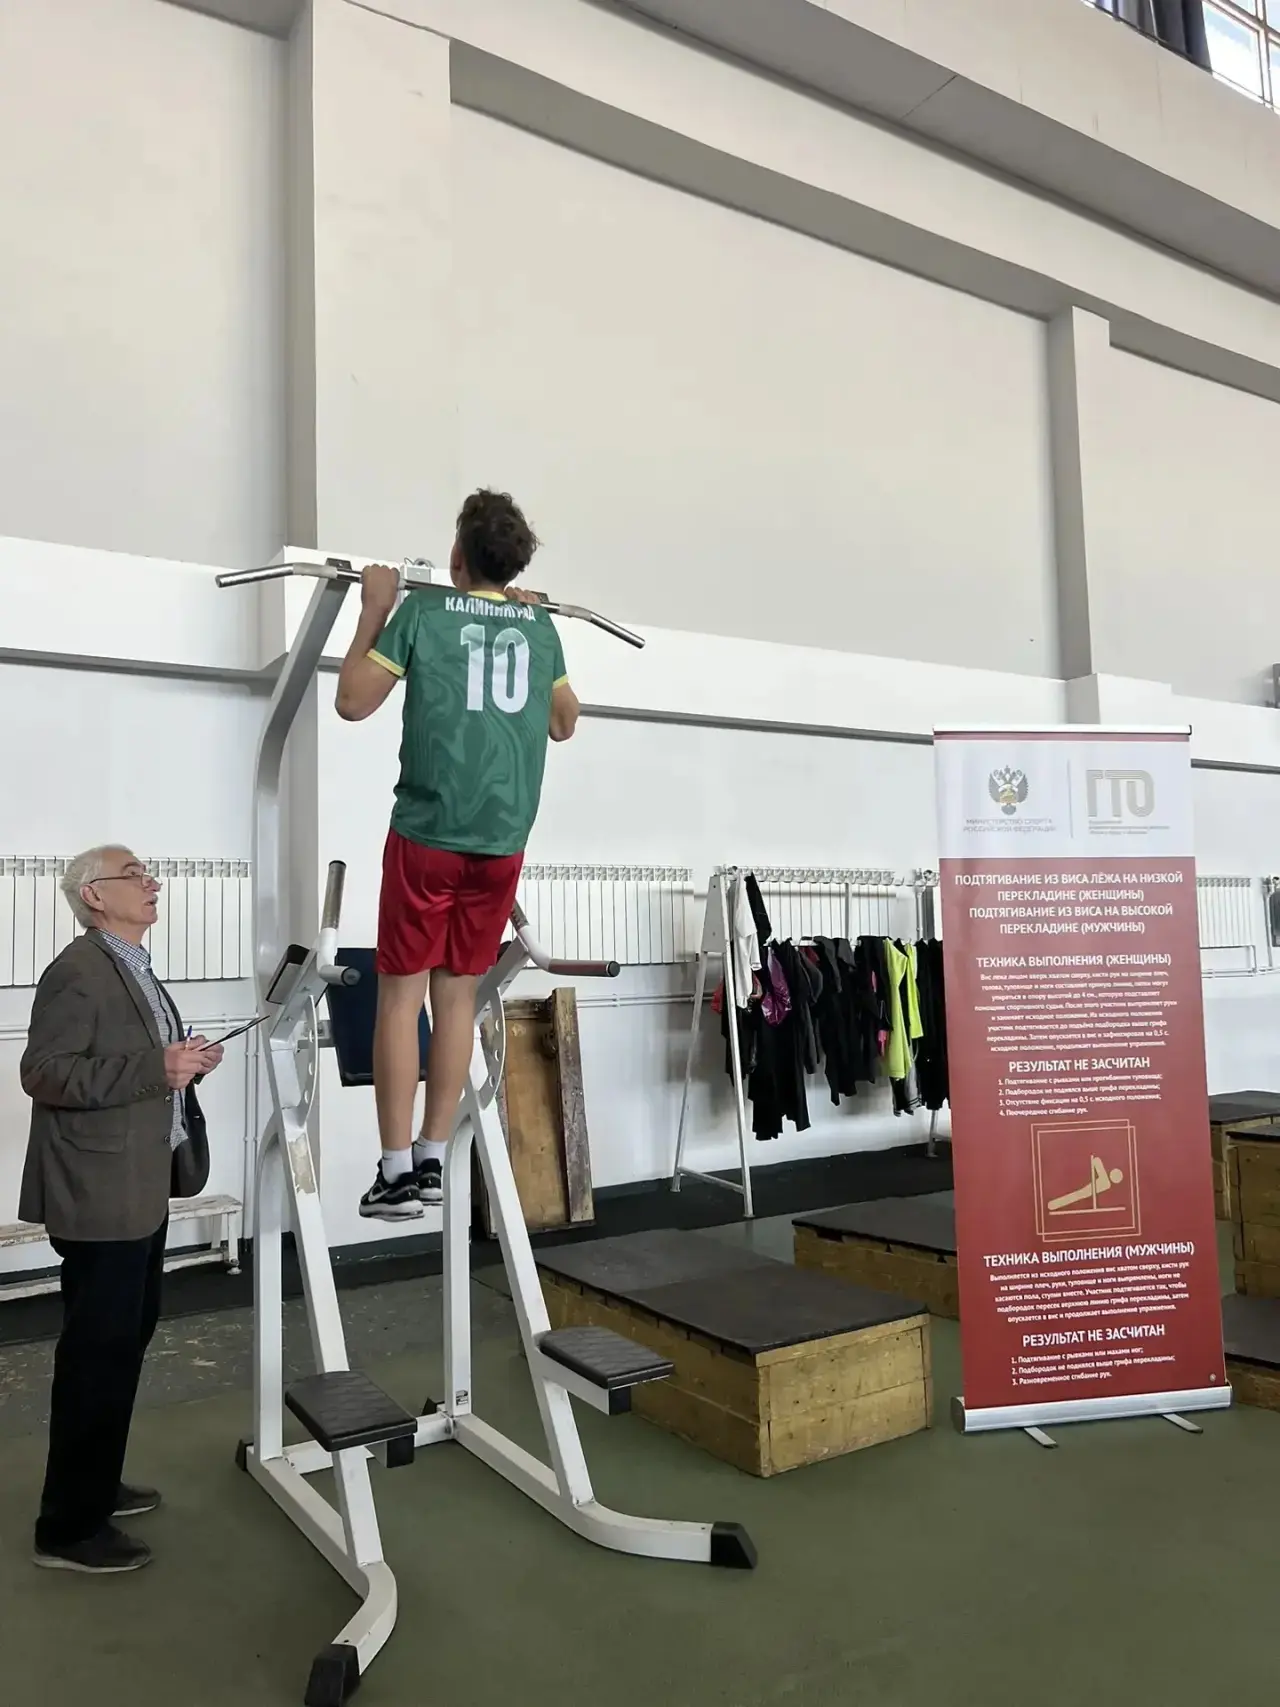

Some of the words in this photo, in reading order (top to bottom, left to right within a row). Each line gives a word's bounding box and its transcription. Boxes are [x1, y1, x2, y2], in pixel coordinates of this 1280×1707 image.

[460, 624, 530, 714] 10
[1086, 770, 1155, 818] ГТО
[955, 874, 1042, 885] ПОДТЯГИВАНИЕ
[1044, 874, 1059, 884] ИЗ
[1061, 874, 1089, 884] ВИСА
[1123, 874, 1137, 883] НА
[1140, 871, 1183, 883] НИЗКОЙ
[998, 890, 1076, 901] ПЕРЕКЛАДИНЕ
[1079, 890, 1144, 901] (ЖЕНЩИНЫ)
[970, 907, 1055, 918] ПОДТЯГИВАНИЕ
[1058, 906, 1072, 917] ИЗ
[1075, 906, 1102, 916] ВИСА
[1105, 906, 1119, 916] НА
[1121, 903, 1172, 916] ВЫСОКОЙ
[1000, 923, 1079, 934] ПЕРЕКЛАДИНЕ
[1081, 922, 1145, 934] (МУЖЧИНЫ)
[976, 957, 1026, 967] ТЕХНИКА
[1028, 955, 1103, 966] ВЫПОЛНЕНИЯ
[1106, 954, 1171, 966] (ЖЕНЩИНЫ)
[1009, 1060, 1072, 1072] РЕЗУЛЬТАТ
[1074, 1059, 1089, 1070] НЕ
[1091, 1057, 1150, 1069] ЗАСЧИТАН
[983, 1253, 1039, 1267] ТЕХНИКА
[1042, 1246, 1122, 1263] ВЫПОЛНЕНИЯ
[1125, 1242, 1195, 1258] (МУЖЧИНЫ)
[1023, 1331, 1084, 1346] РЕЗУЛЬТАТ
[1088, 1329, 1102, 1341] НЕ
[1106, 1325, 1166, 1340] ЗАСЧИТАН
